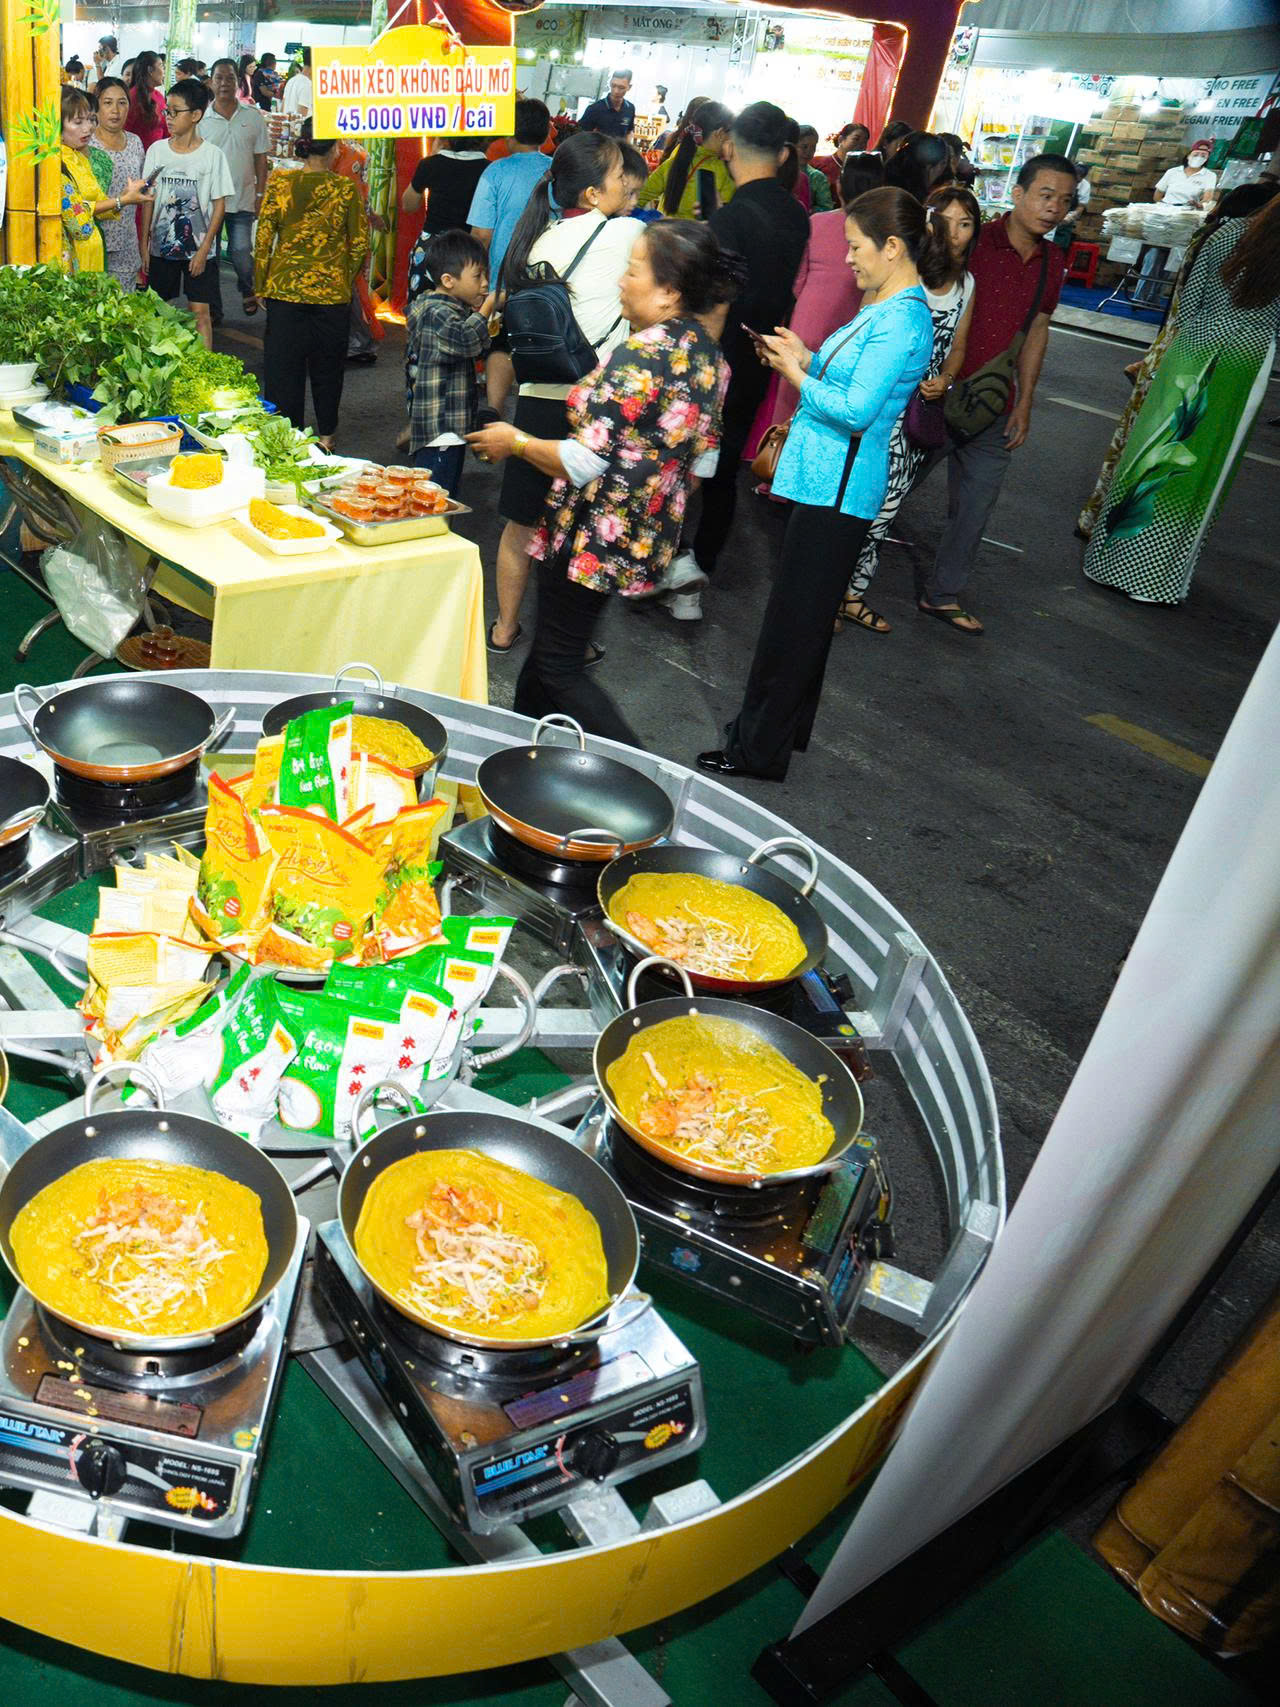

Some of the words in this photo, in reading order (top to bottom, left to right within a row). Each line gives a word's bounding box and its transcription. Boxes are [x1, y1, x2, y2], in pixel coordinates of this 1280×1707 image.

[320, 61, 361, 95] BÁNH
[367, 61, 395, 95] XÈO
[400, 61, 450, 94] KHÔNG
[1231, 78, 1260, 90] FREE
[1232, 97, 1261, 108] FREE
[337, 107, 402, 131] 45.000
[409, 106, 446, 129] VNĐ
[466, 105, 493, 128] cái
